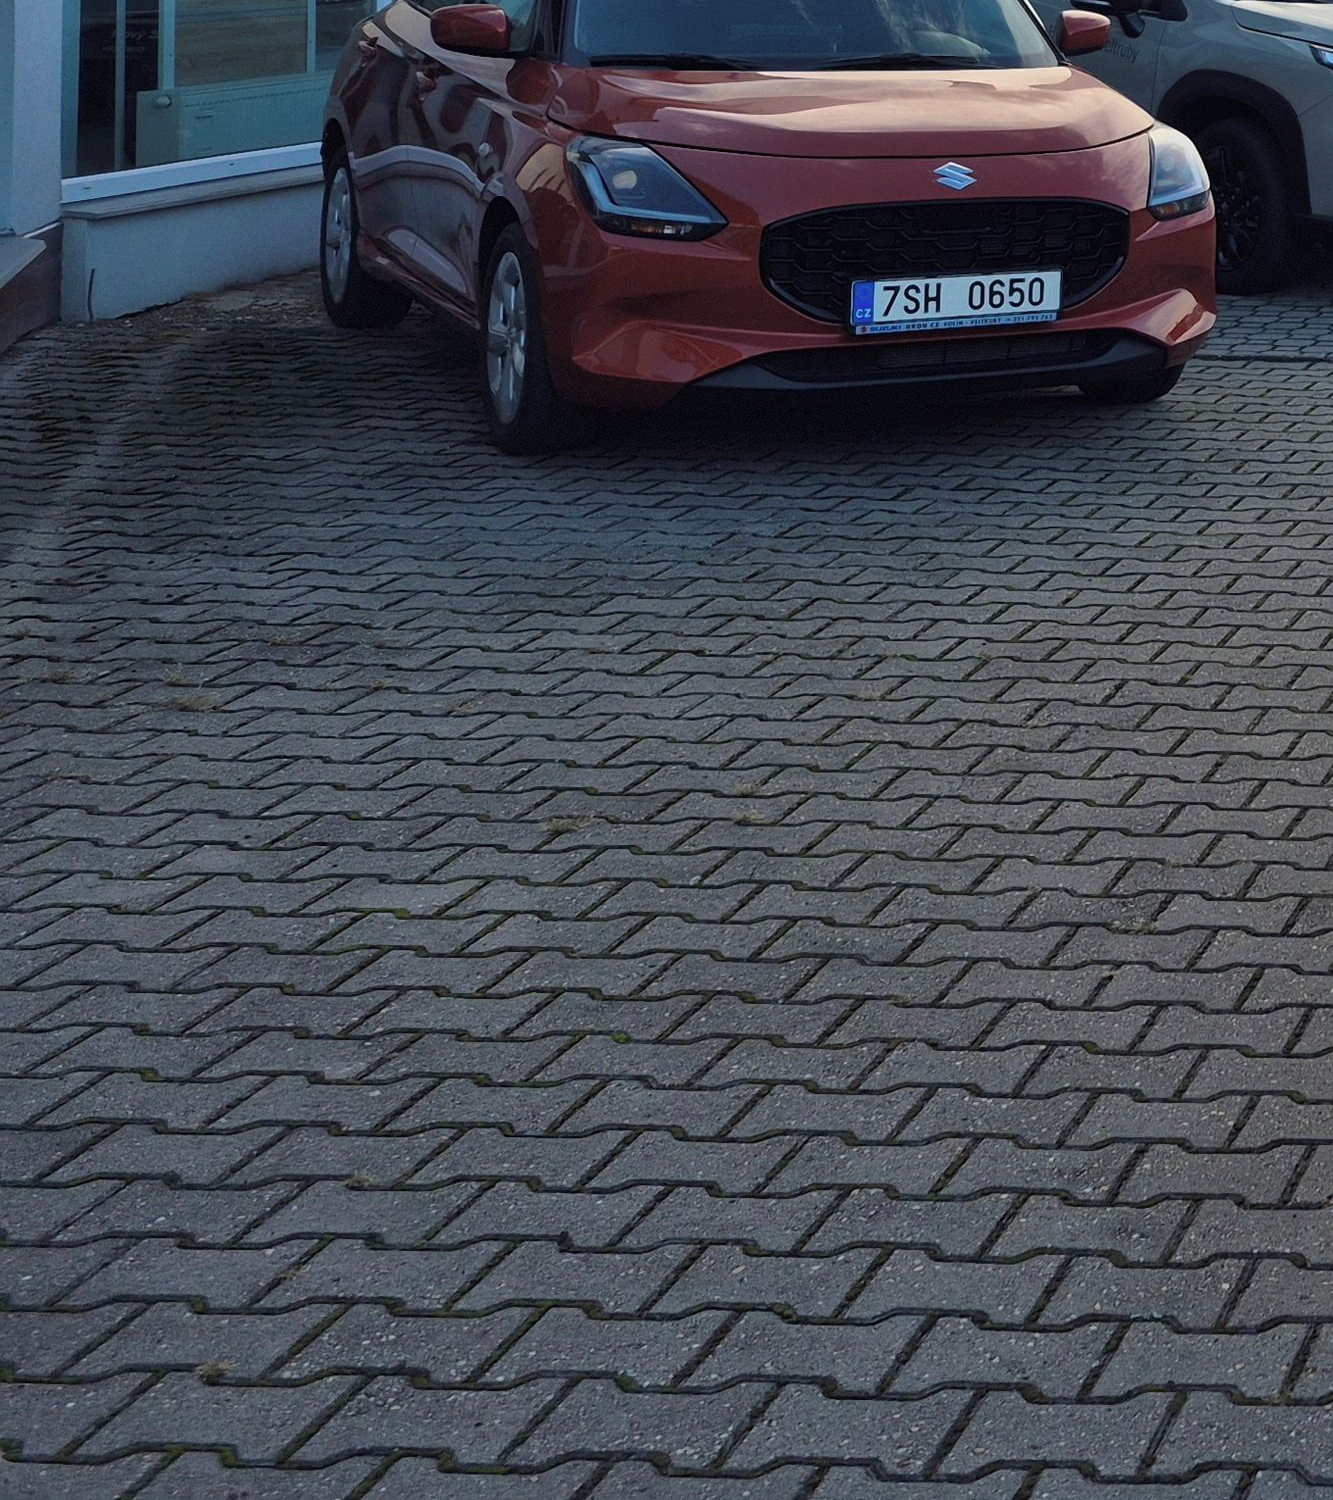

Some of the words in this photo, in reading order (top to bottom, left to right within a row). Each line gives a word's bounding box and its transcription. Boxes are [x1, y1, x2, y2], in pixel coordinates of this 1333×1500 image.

[882, 282, 941, 317] 7SH
[968, 277, 1045, 311] 0650
[856, 308, 872, 318] CZ
